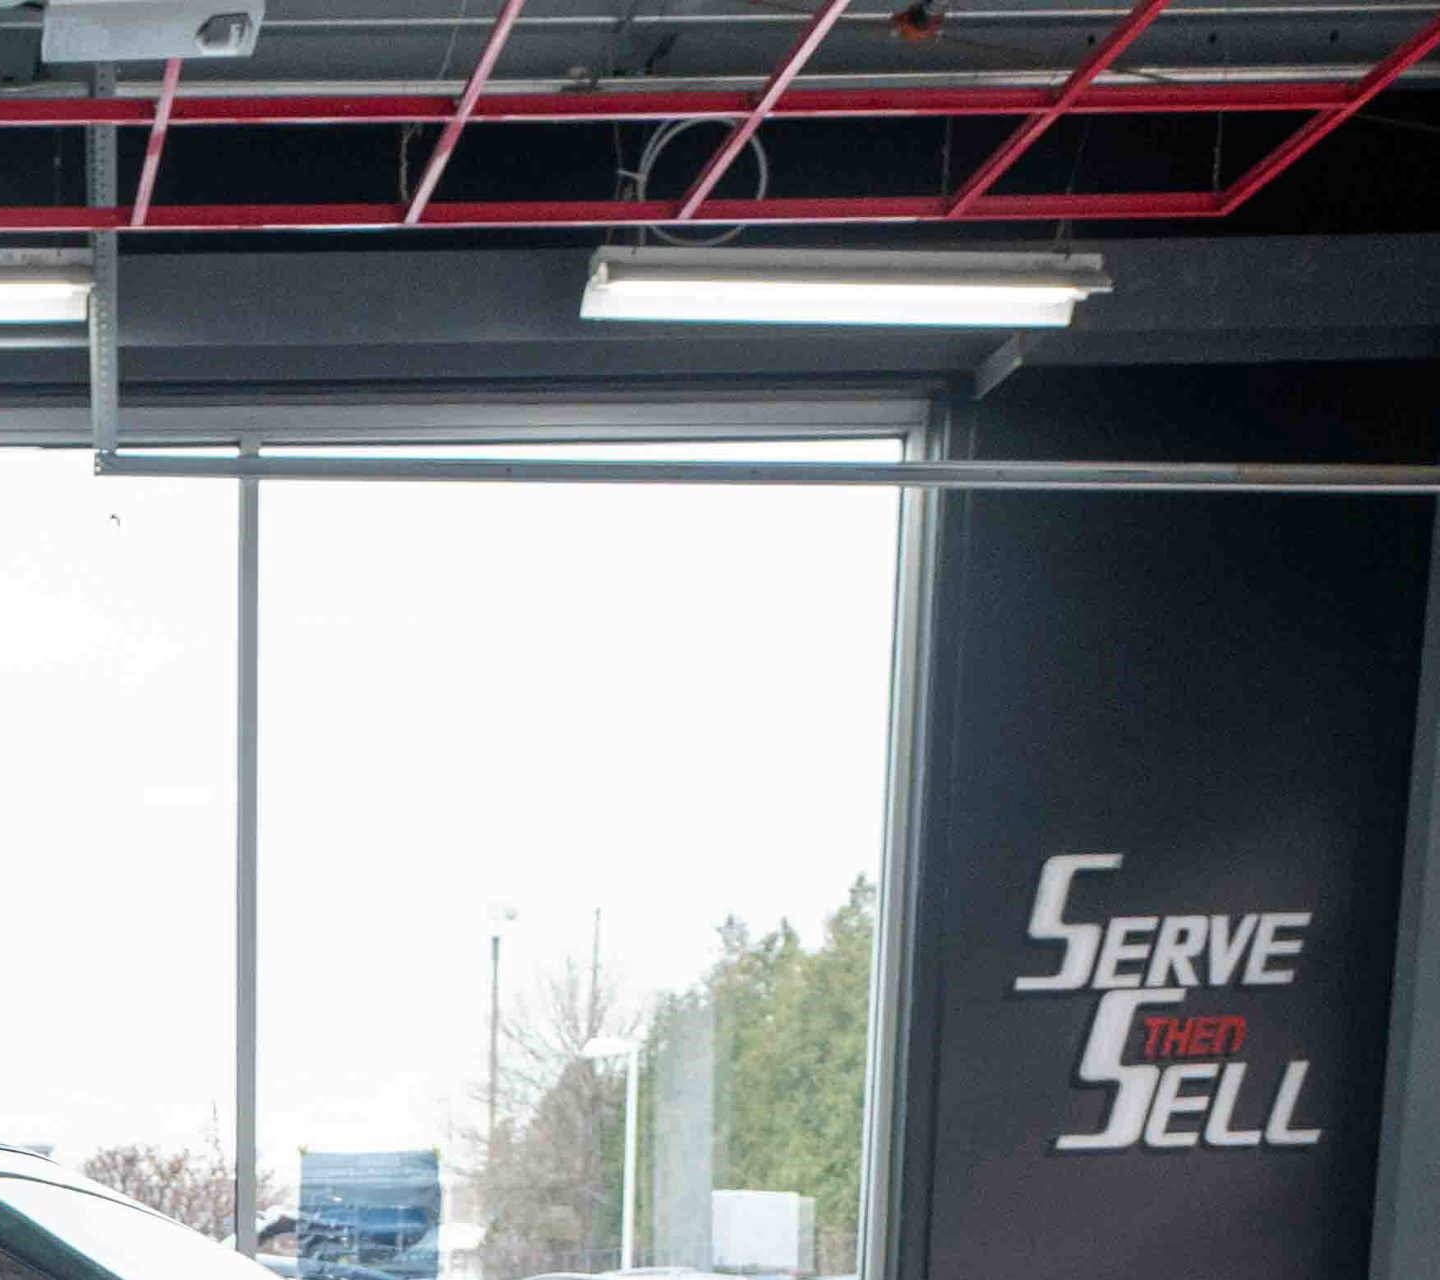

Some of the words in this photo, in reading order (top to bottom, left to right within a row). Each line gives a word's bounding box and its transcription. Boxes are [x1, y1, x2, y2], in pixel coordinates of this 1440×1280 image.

[1014, 853, 1312, 991] SERVE
[1055, 987, 1322, 1150] SELL
[1141, 1015, 1247, 1060] THEN
